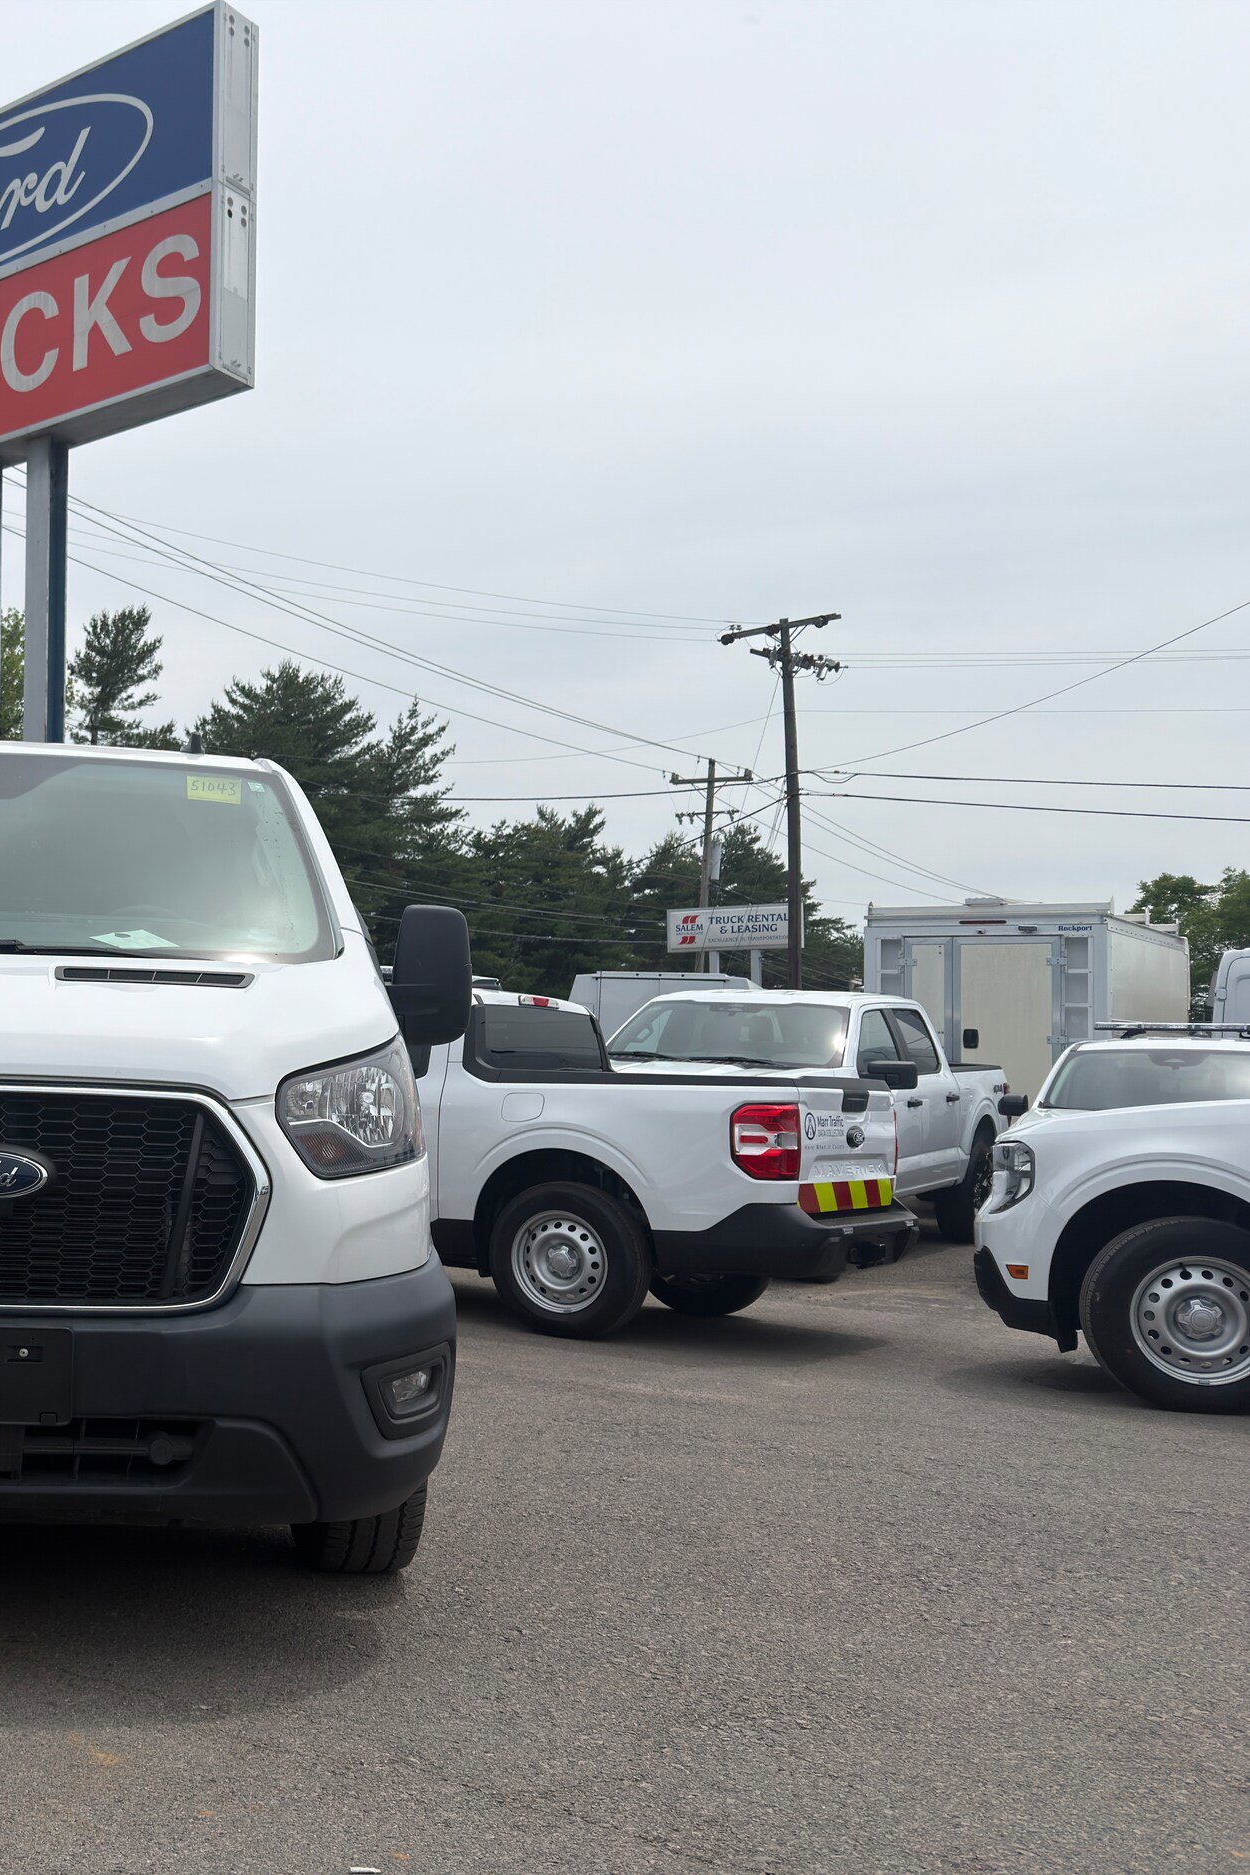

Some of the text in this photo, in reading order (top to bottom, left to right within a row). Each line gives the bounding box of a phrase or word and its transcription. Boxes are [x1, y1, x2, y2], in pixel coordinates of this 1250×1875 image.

[190, 780, 237, 796] 51043
[708, 913, 789, 925] TRUCK RENTAL
[675, 923, 704, 932] SALEM
[719, 923, 778, 934] & LEASING
[747, 934, 789, 942] TRANSPORTATIO
[829, 1115, 844, 1127] Traffic
[814, 1163, 883, 1177] MAVERICK
